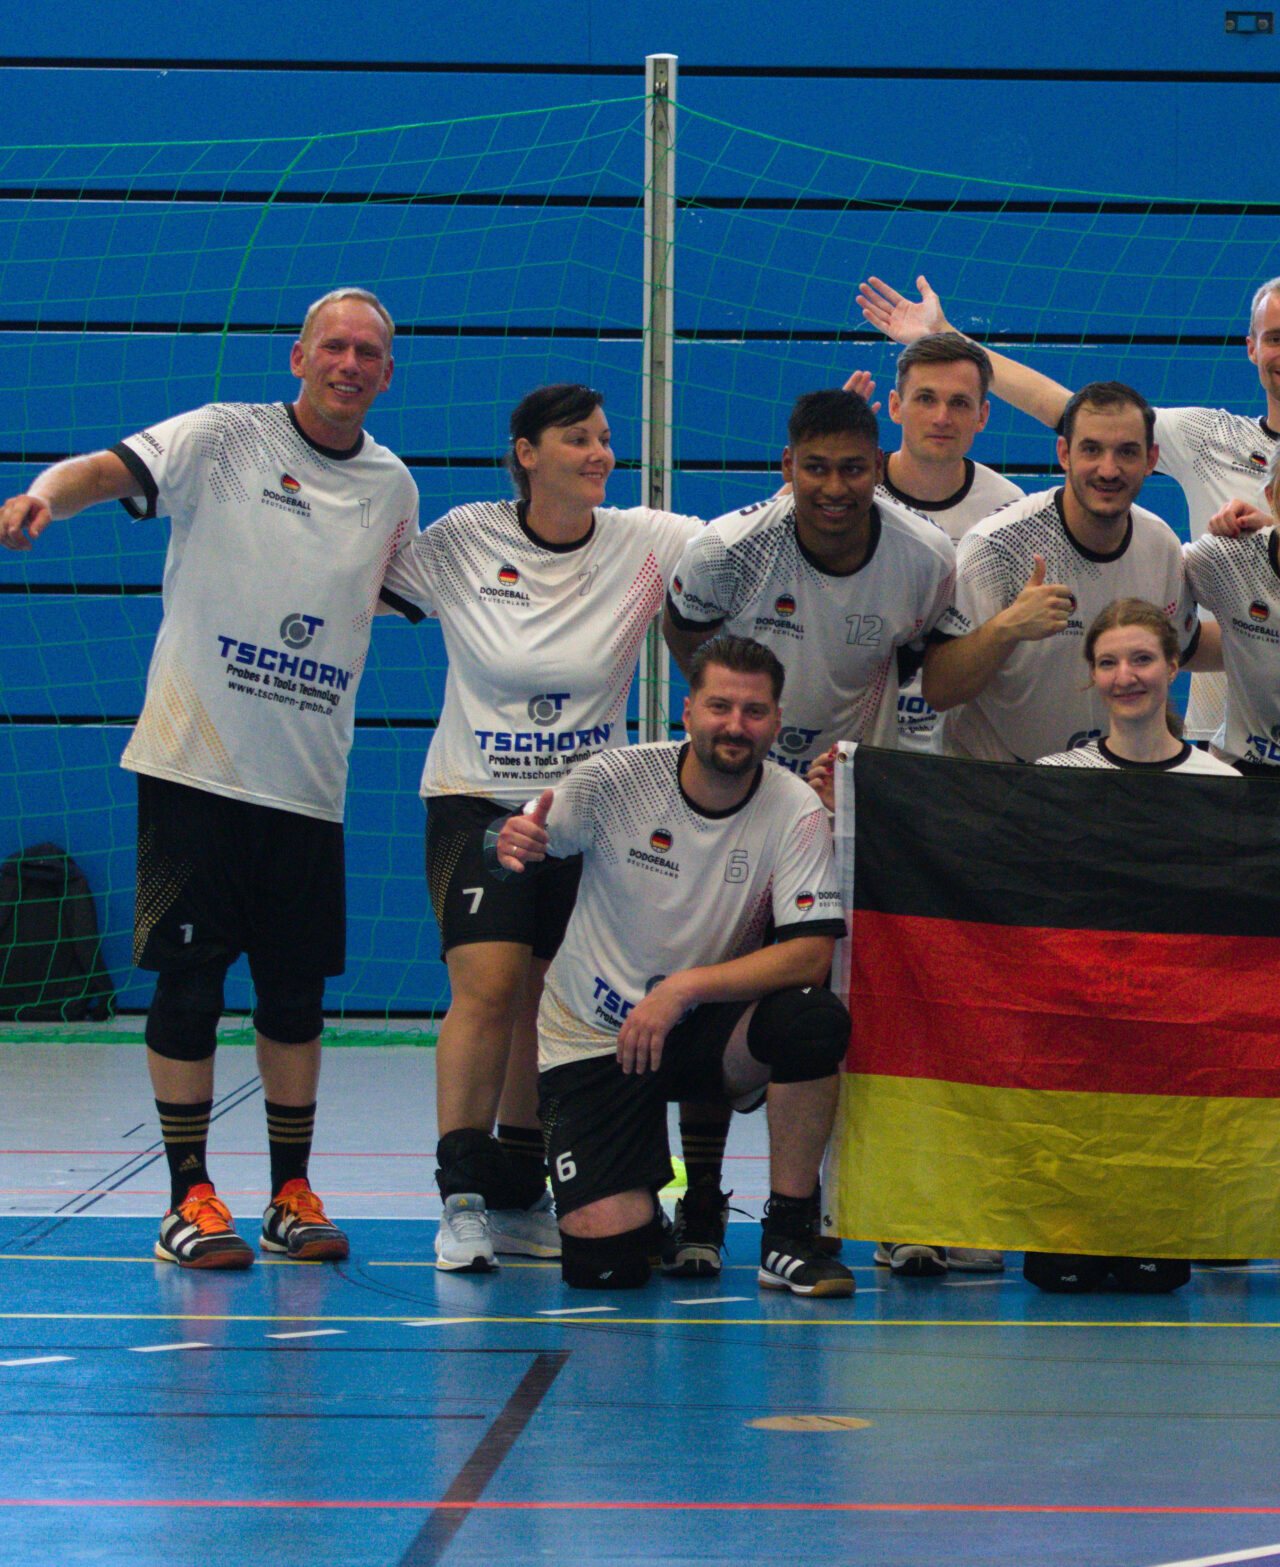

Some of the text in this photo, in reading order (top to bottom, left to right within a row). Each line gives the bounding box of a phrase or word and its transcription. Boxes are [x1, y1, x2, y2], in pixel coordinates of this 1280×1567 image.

[261, 498, 311, 518] DEUTSCHLAND
[263, 488, 312, 511] DODGEBALL
[359, 497, 371, 528] 1
[478, 595, 530, 607] DEUTSCHLAND
[480, 586, 530, 601] DODGEBALL
[755, 618, 804, 633] DODGEBALL
[846, 614, 883, 647] 12
[1233, 618, 1280, 638] DODGEBALL
[226, 664, 340, 706] Probes & Tools Technology
[489, 750, 600, 766] Probes & Tools Technol
[493, 769, 572, 780] www.tschorn-
[627, 858, 679, 879] DEUTSCHLAND
[629, 848, 680, 872] DODGEBALL
[724, 849, 749, 883] 6
[462, 887, 484, 914] 7
[818, 891, 841, 900] DODGE
[179, 924, 194, 943] 1
[555, 1151, 577, 1183] 6
